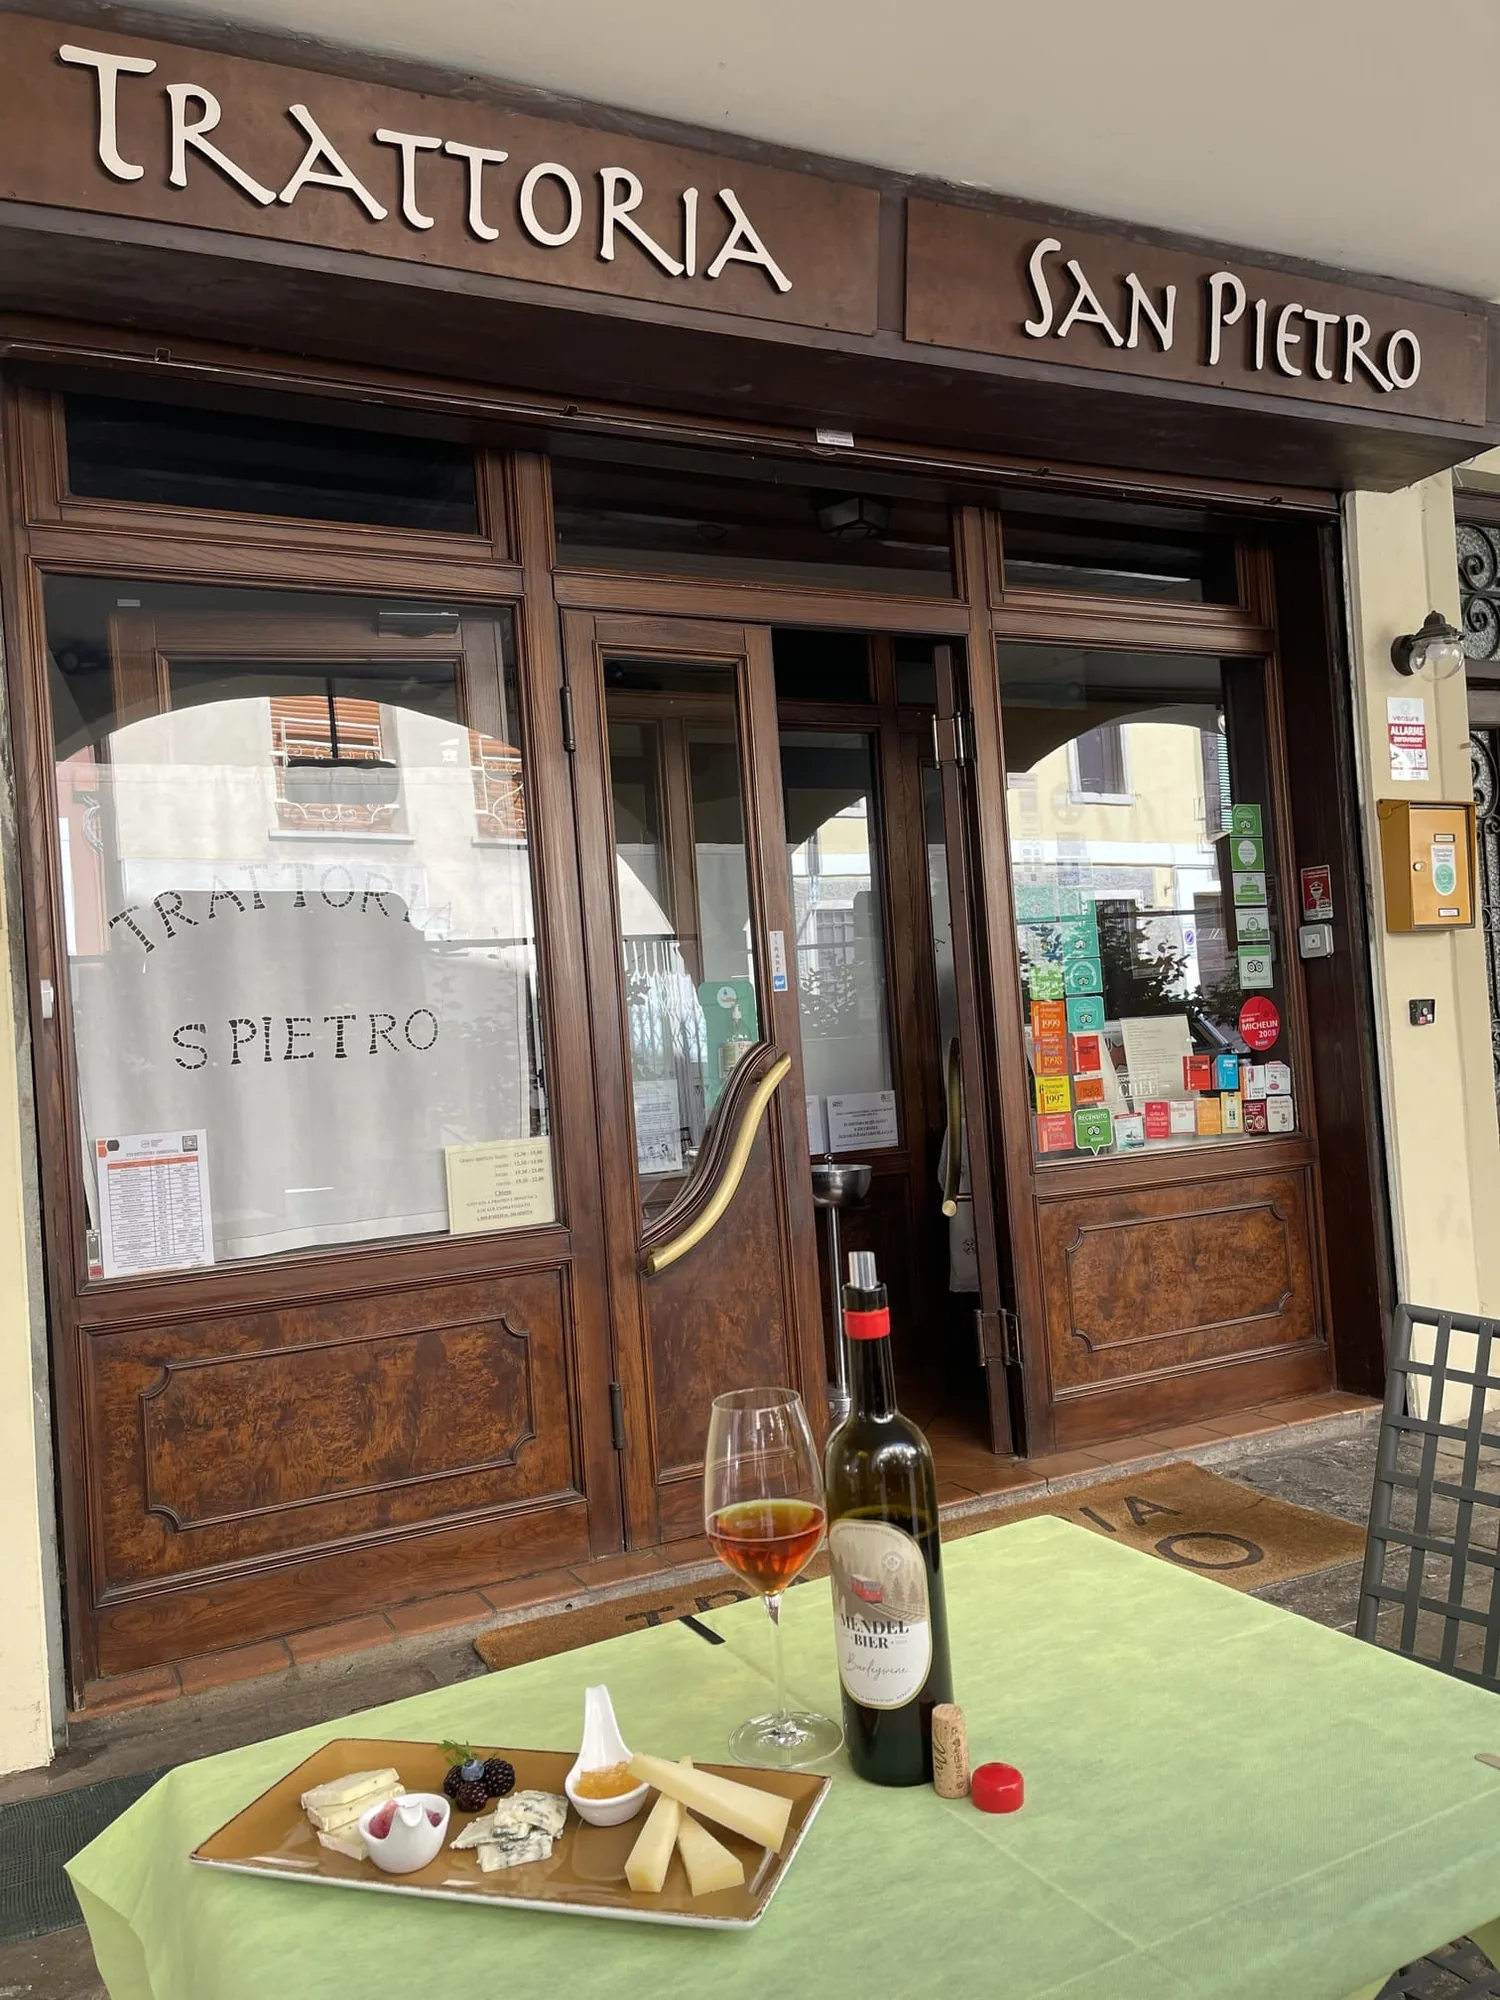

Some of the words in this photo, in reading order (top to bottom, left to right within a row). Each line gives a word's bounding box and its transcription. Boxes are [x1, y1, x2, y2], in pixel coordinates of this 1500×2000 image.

[59, 44, 793, 292] TRATTORIA
[1023, 237, 1177, 351] SAN
[1207, 271, 1421, 391] PIETRO
[1390, 725, 1424, 736] ALLARME
[1042, 1019, 1060, 1029] 1999
[1242, 1019, 1278, 1031] MICHELIN
[173, 1023, 208, 1070] S
[228, 1008, 439, 1067] PIETRO
[1046, 1094, 1064, 1105] 1997
[1078, 1113, 1108, 1121] RECENSITO
[840, 1613, 909, 1635] MENDEL
[854, 1633, 888, 1649] BIER
